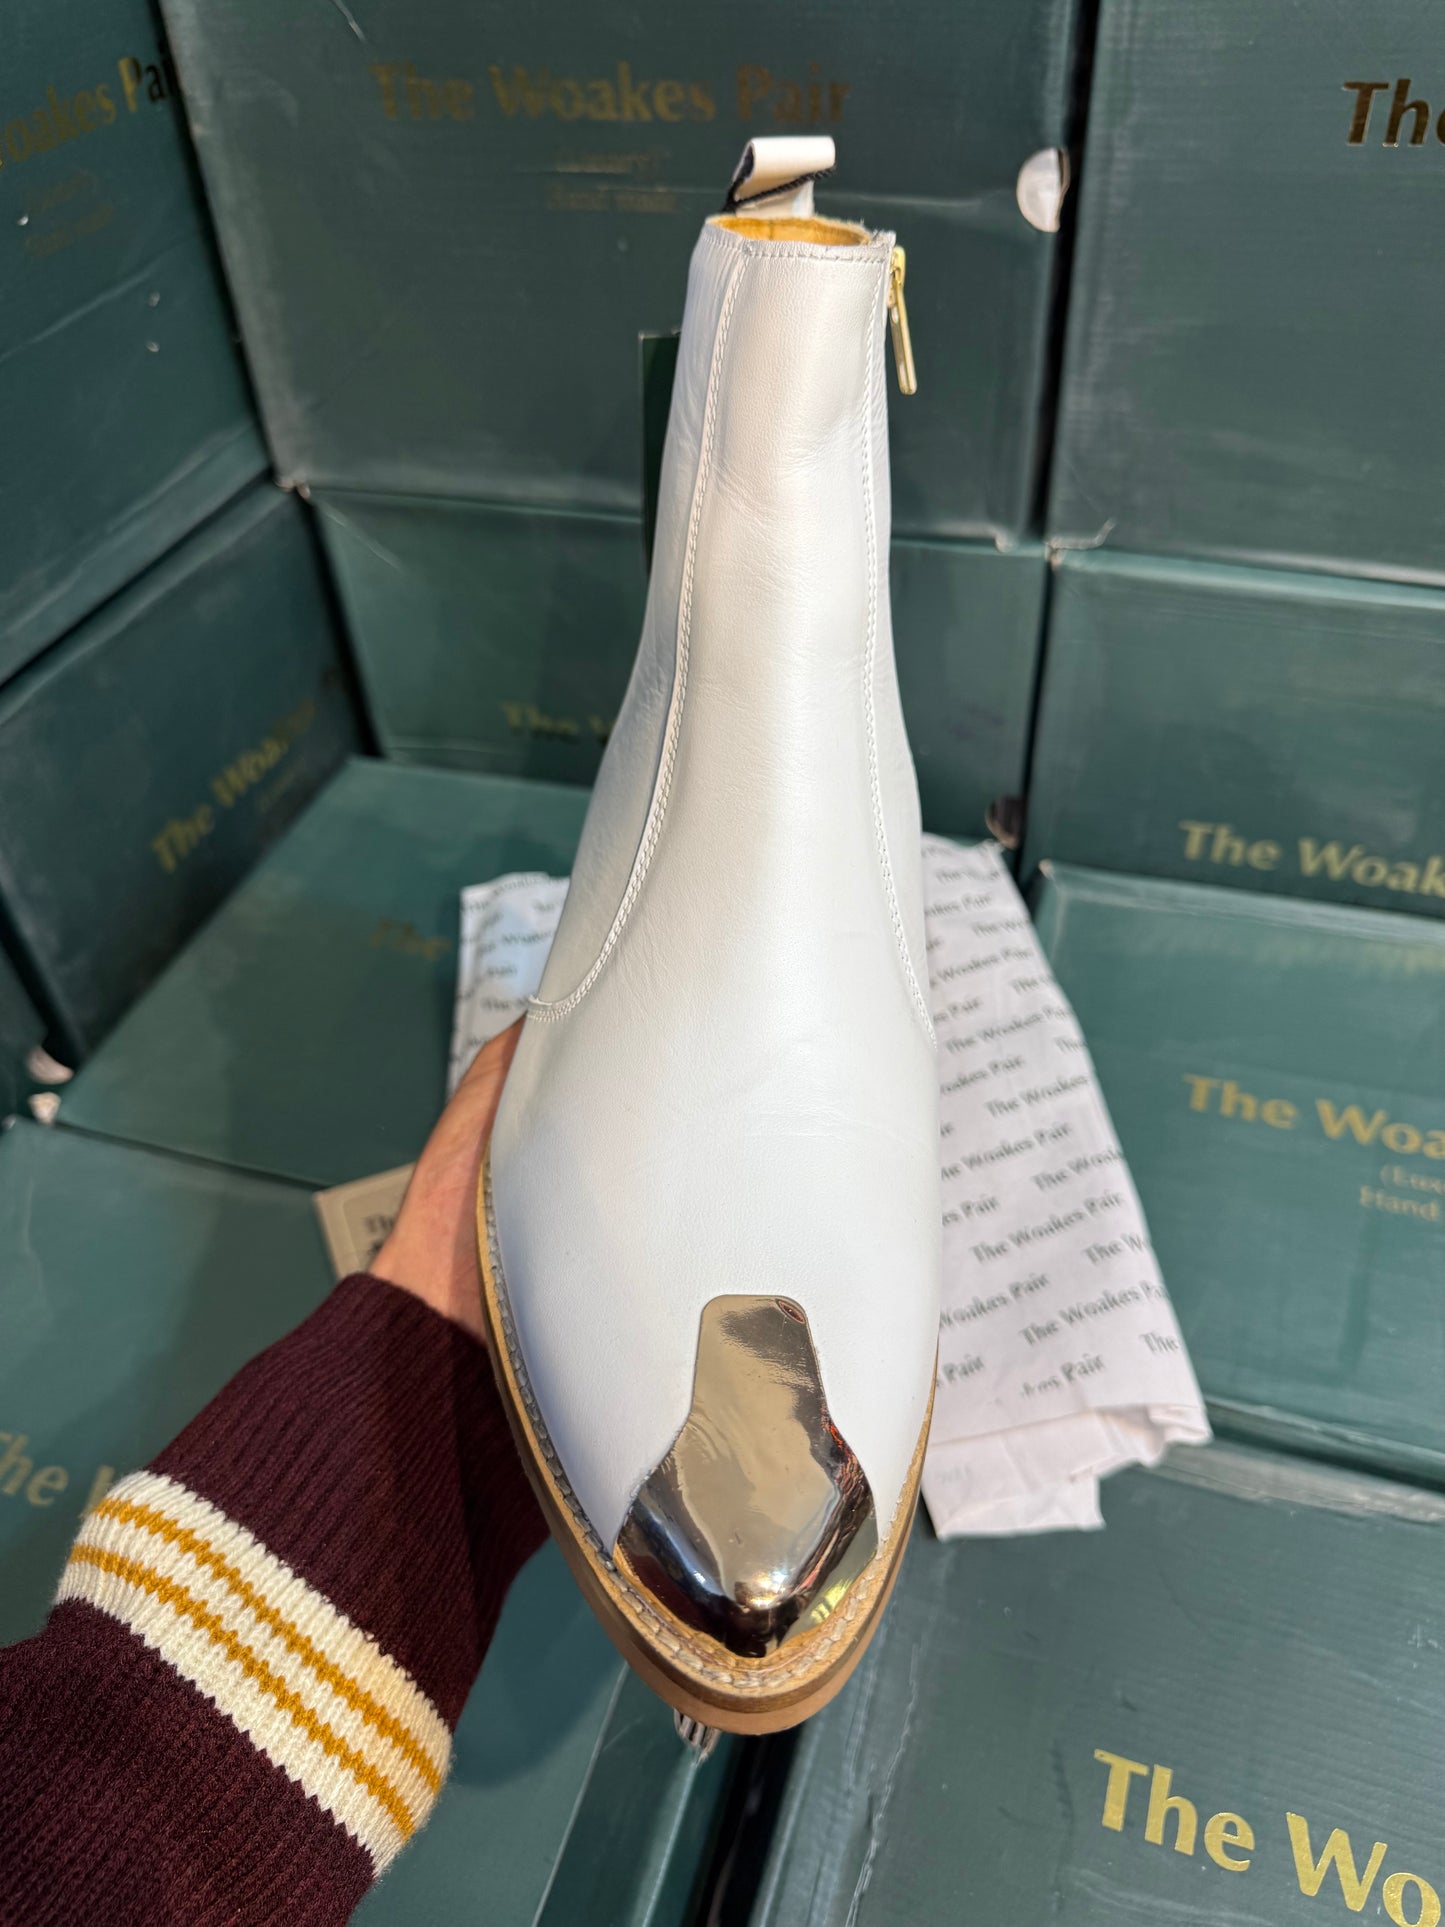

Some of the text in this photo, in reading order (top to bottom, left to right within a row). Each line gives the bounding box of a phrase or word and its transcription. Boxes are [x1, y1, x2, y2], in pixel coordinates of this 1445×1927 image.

[368, 60, 850, 122] The Woakes Pair
[1341, 77, 1445, 147] Th
[0, 83, 117, 168] oakes
[1179, 819, 1282, 872] The
[977, 1011, 1043, 1042] Woakes
[988, 1055, 1025, 1076] Pair
[985, 1075, 1089, 1118] The Woakes
[1182, 1072, 1298, 1130] The
[960, 1136, 1035, 1171] Woakes
[1033, 1121, 1073, 1148] Pair
[1031, 1169, 1068, 1192] The
[960, 1193, 1000, 1219] Pair
[1359, 1184, 1440, 1222] Hand
[970, 1189, 1122, 1265] The Woakes Pair
[1081, 1242, 1123, 1265] The
[1008, 1271, 1050, 1301] Pair
[1018, 1320, 1060, 1346] The
[1059, 1287, 1141, 1327] Woakes
[942, 1354, 985, 1384] Pair
[1060, 1352, 1105, 1383] Pair
[1094, 1748, 1442, 1927] The Wo
